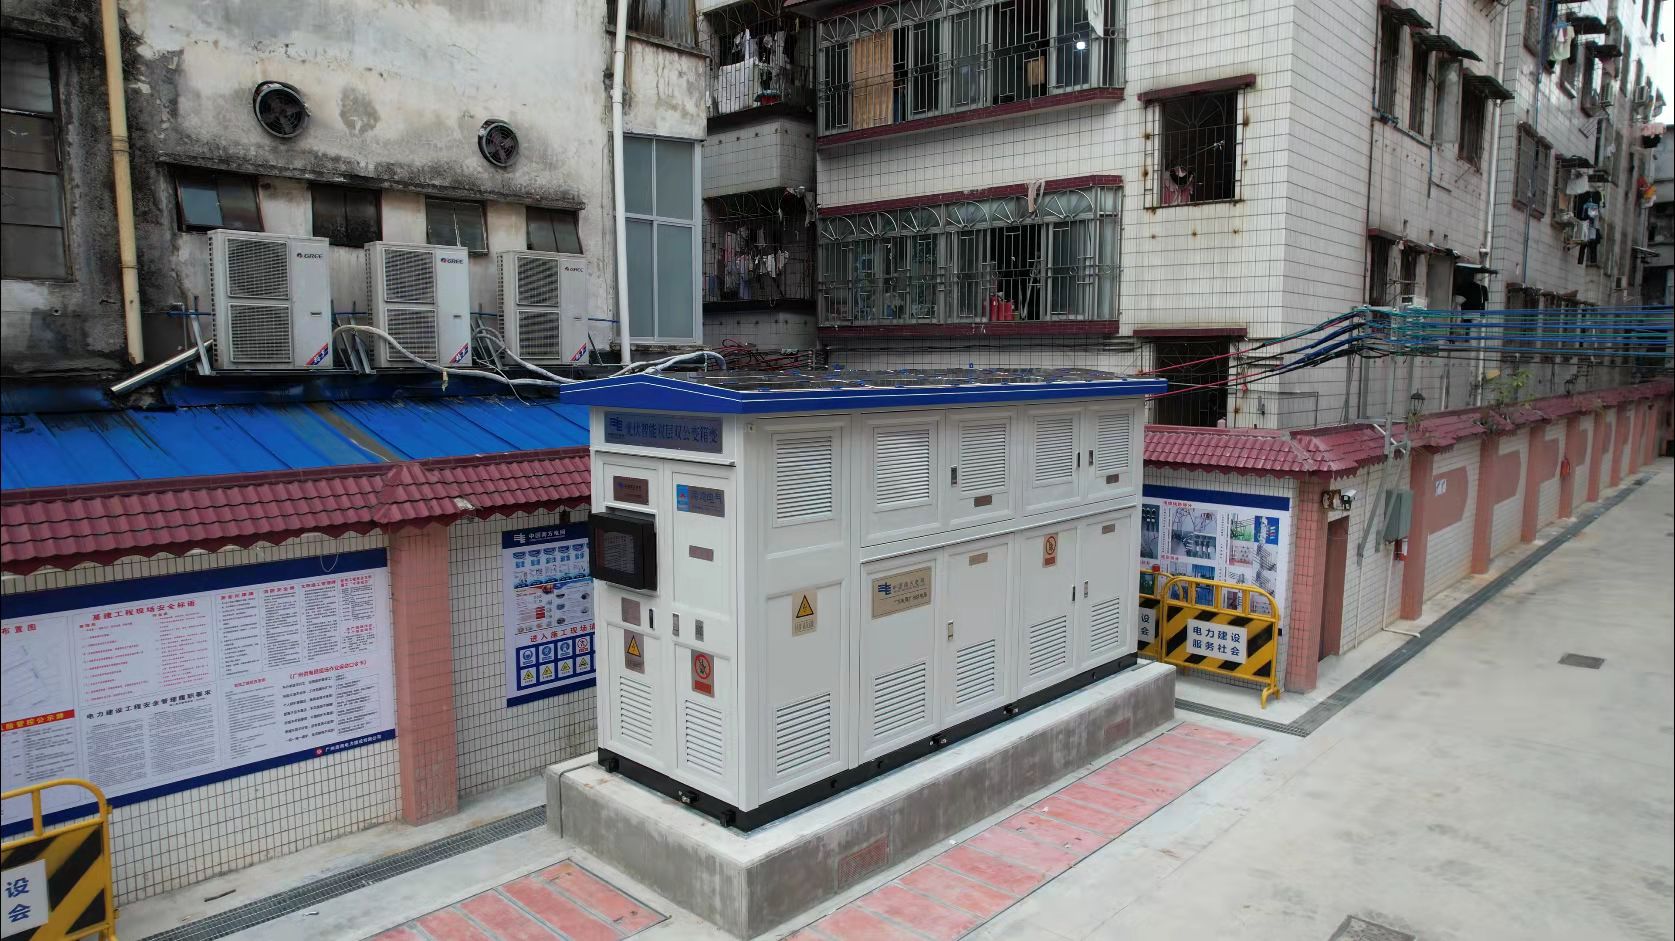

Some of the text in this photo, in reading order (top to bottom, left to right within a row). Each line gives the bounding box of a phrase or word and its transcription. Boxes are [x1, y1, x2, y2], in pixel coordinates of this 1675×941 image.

[92, 600, 196, 621] 基建工程现场安全标语
[1192, 625, 1241, 643] 电力建设
[1192, 638, 1241, 657] 服务社会
[5, 877, 30, 898] 设
[8, 903, 32, 923] 会
